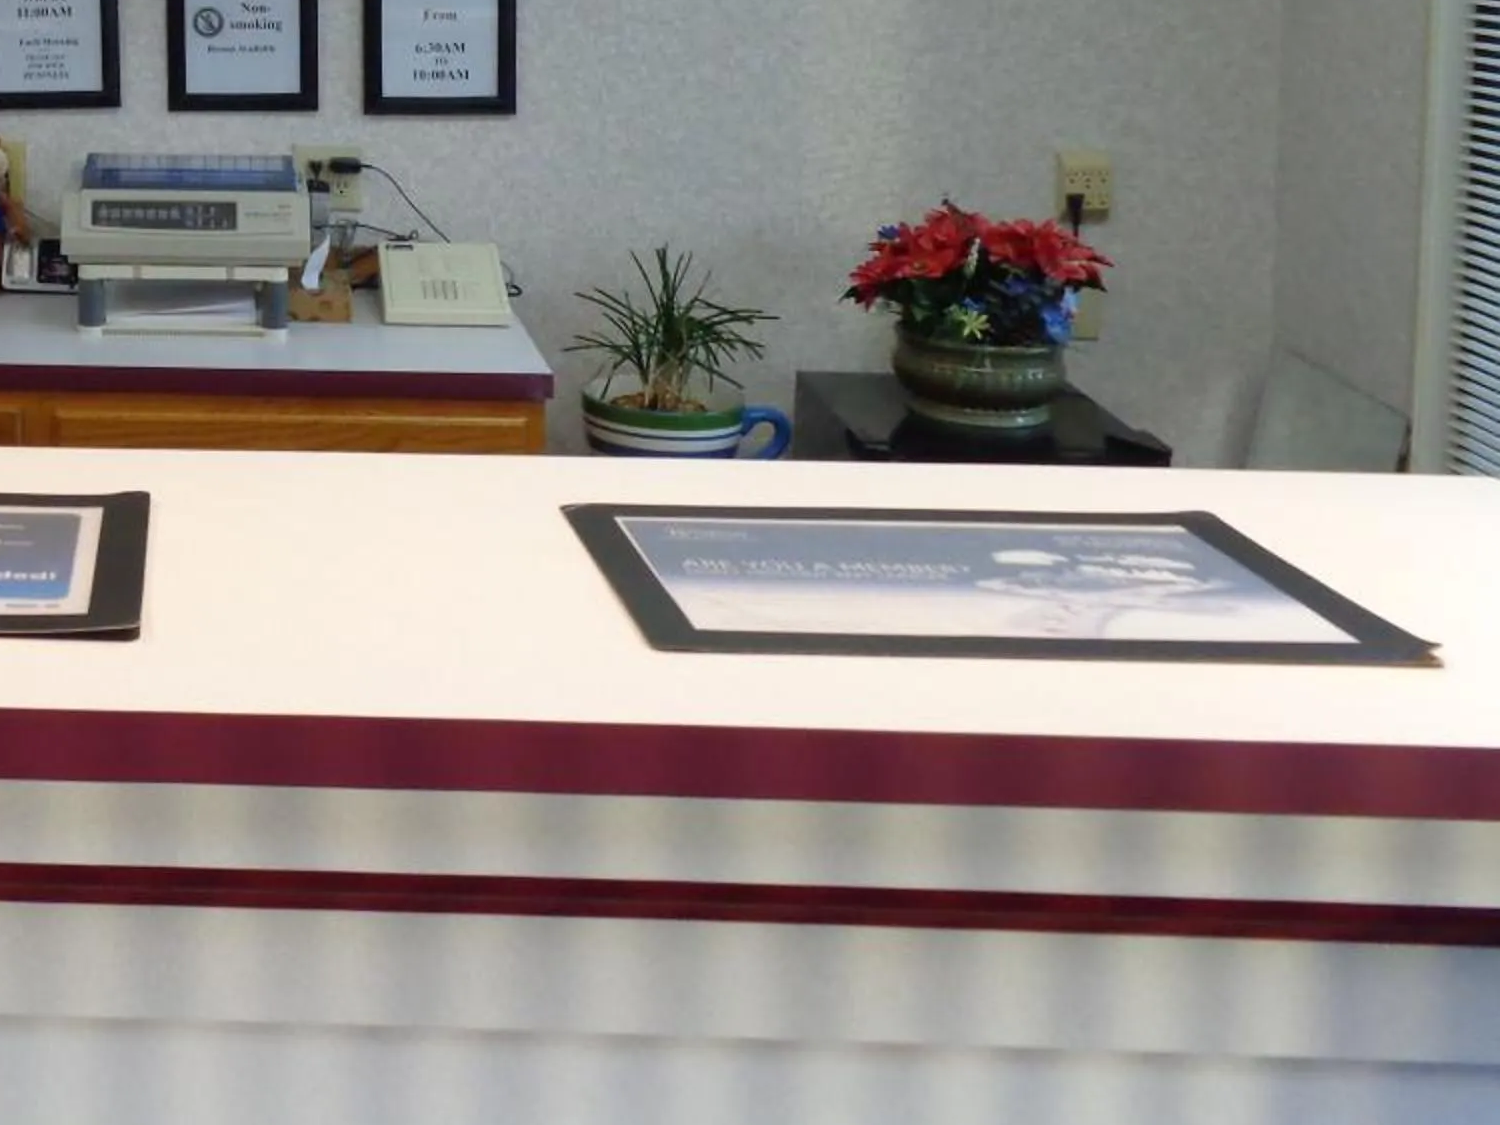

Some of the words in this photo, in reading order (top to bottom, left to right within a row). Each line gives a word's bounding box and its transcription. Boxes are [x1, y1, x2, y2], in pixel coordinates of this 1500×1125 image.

[241, 1, 271, 13] Non-
[423, 9, 458, 21] From
[230, 18, 283, 32] smoking
[414, 42, 465, 54] 6:30AM
[413, 68, 469, 81] 10:00AM
